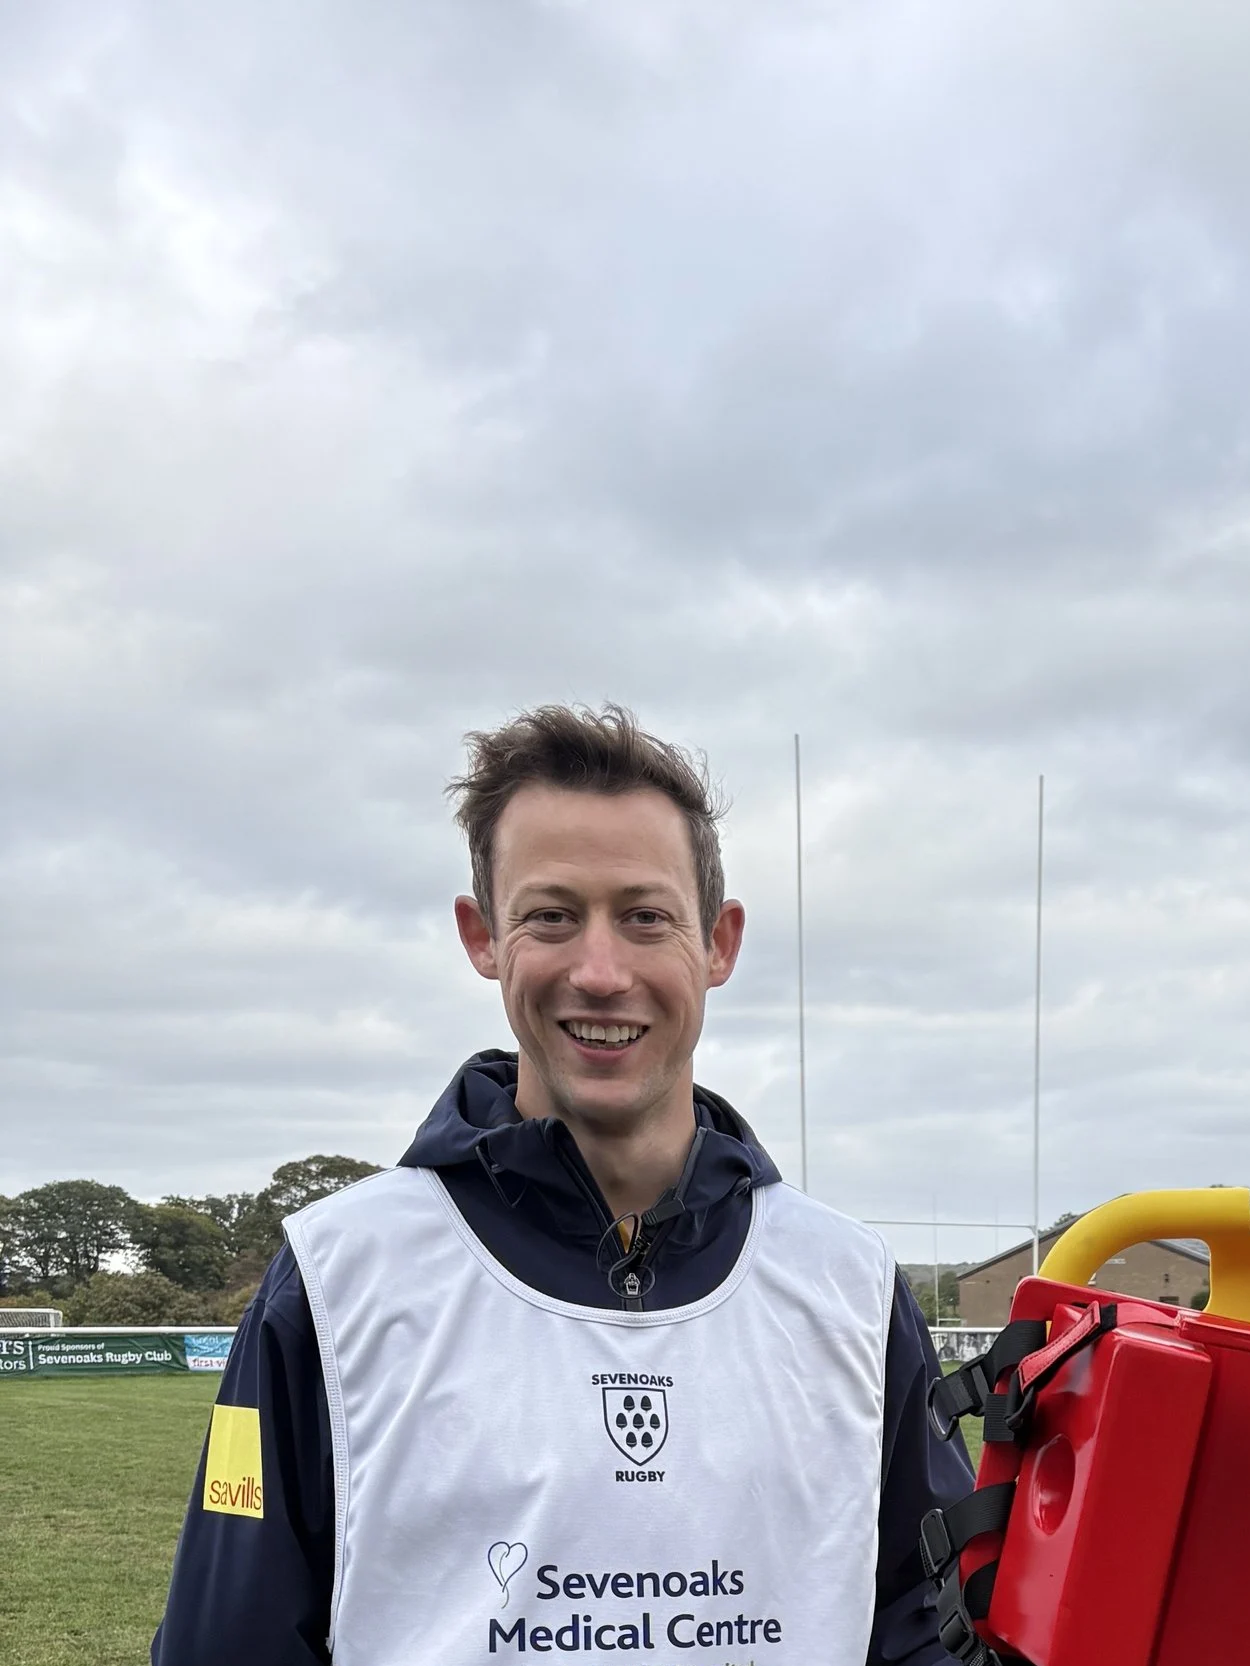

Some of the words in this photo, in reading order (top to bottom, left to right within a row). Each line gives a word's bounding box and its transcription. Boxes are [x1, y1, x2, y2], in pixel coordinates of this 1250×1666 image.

[38, 1344, 60, 1352] Proud
[61, 1343, 96, 1352] Sponsors
[97, 1342, 105, 1350] of
[38, 1352, 104, 1365] Sevenoaks
[105, 1351, 142, 1365] Rugby
[145, 1350, 172, 1362] Club
[591, 1373, 674, 1388] SEVENOAKS
[615, 1471, 666, 1482] RUGBY
[209, 1477, 262, 1511] savills
[536, 1560, 744, 1600] Sevenoaks
[488, 1613, 655, 1653] Medical
[667, 1613, 782, 1648] Centre
